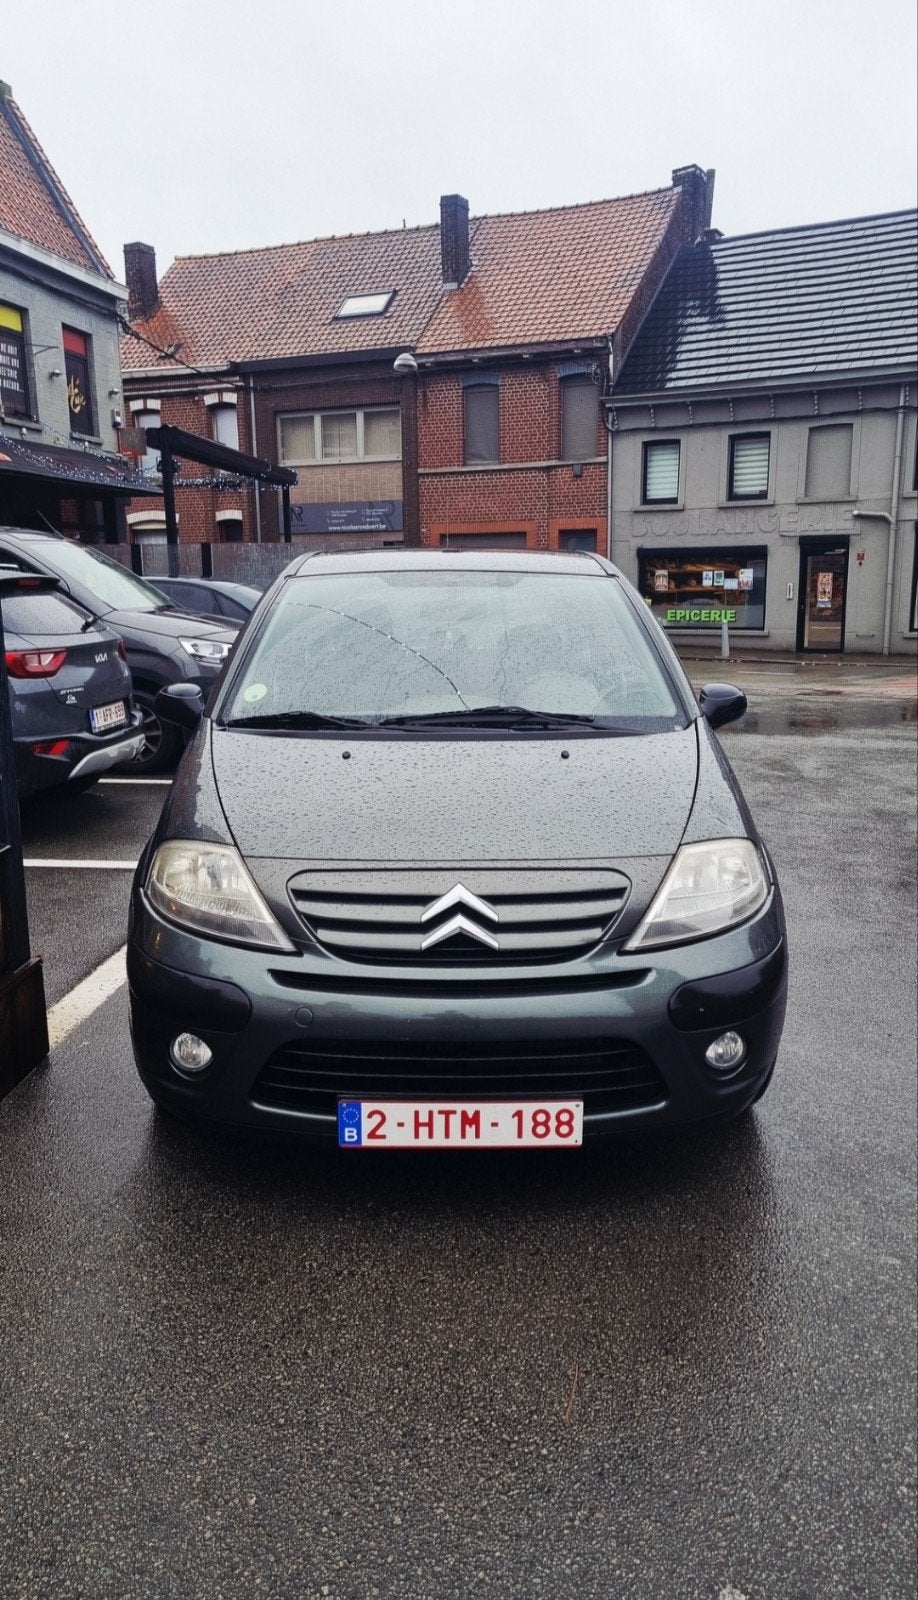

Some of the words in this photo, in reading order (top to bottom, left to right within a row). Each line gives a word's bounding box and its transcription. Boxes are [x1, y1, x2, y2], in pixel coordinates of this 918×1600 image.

[667, 609, 736, 622] EPICERIE
[366, 1108, 575, 1140] 2-HTM-188
[344, 1128, 358, 1142] B
